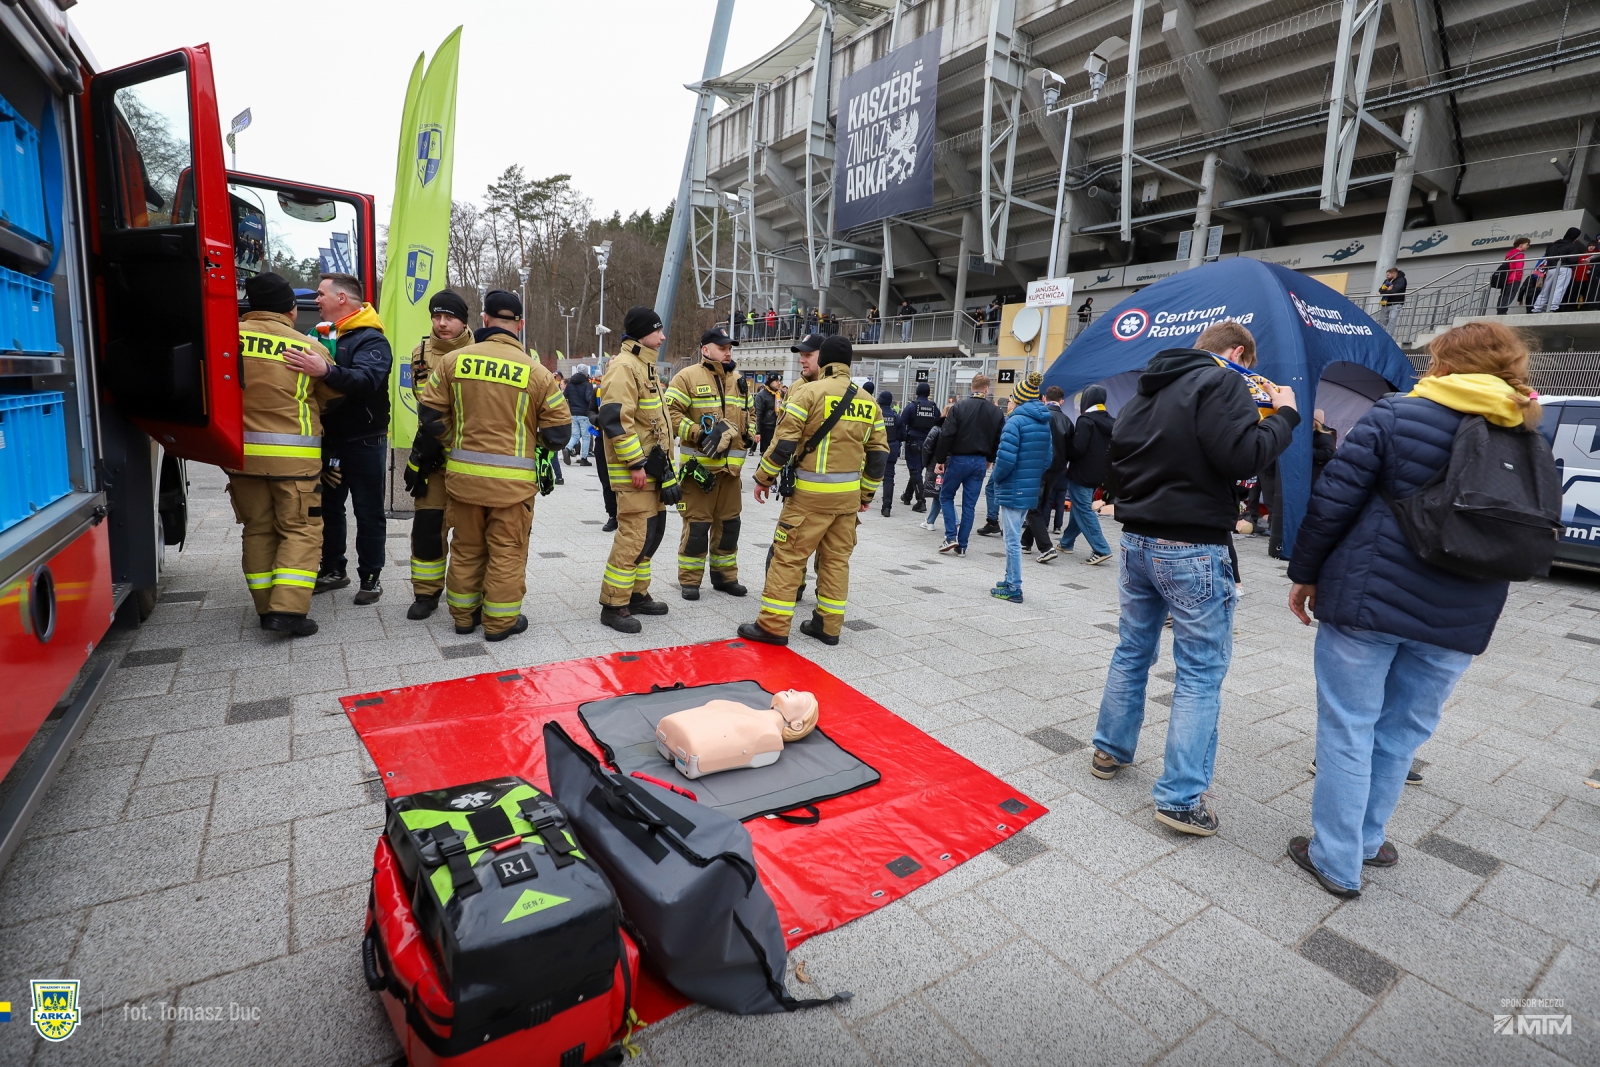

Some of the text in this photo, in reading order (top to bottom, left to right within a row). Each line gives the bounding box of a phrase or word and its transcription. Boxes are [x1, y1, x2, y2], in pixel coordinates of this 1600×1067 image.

[847, 58, 924, 132] KASZËBË
[845, 157, 887, 203] ARKA
[1028, 291, 1065, 301] KUPCEWICZA
[1035, 285, 1060, 293] JANUSZA
[1154, 305, 1227, 324] Centrum
[1147, 312, 1254, 338] Ratowniwa
[1001, 372, 1011, 381] 12
[499, 857, 532, 879] R1
[522, 900, 538, 910] GEN
